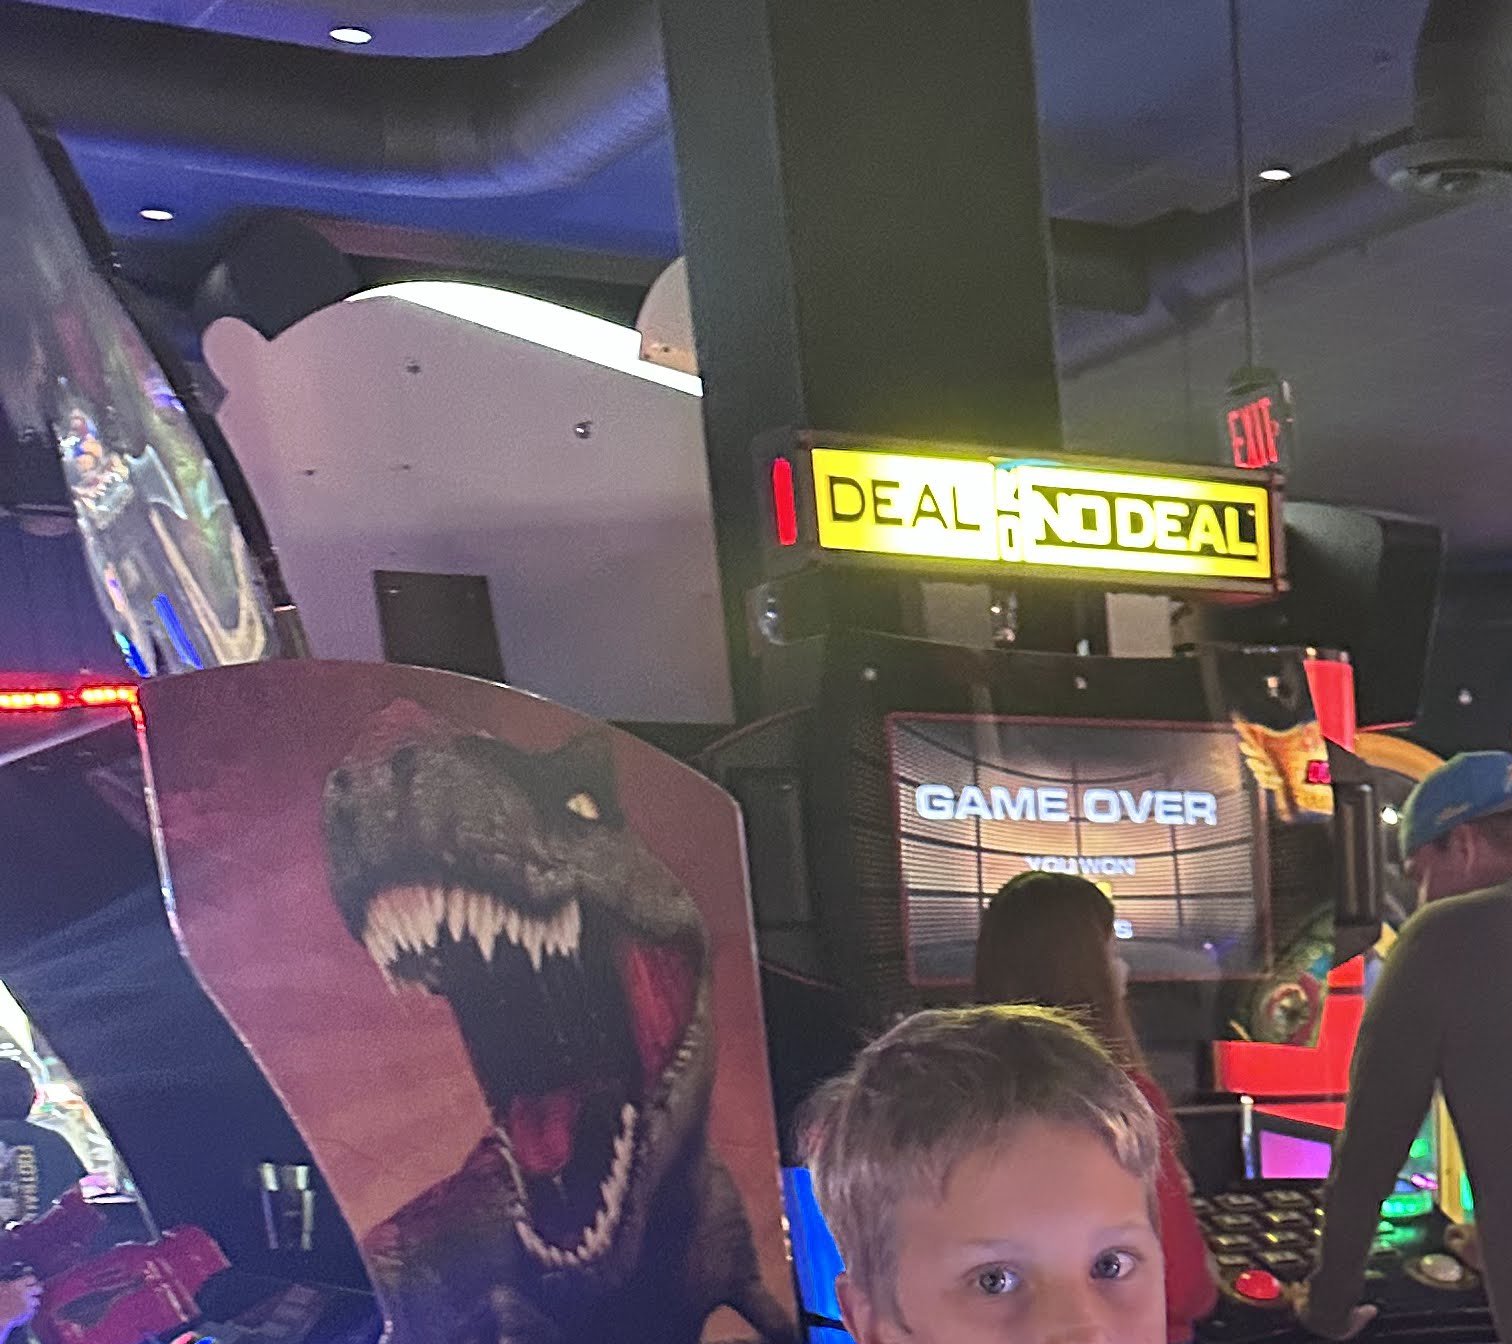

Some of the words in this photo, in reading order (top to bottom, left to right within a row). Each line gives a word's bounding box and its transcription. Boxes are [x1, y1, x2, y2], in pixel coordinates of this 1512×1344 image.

[1227, 397, 1279, 468] EXIT
[828, 475, 981, 532] DEAL
[1032, 487, 1110, 547] NO
[1116, 497, 1257, 557] DEAL
[915, 783, 1070, 822] GAME
[1083, 788, 1217, 826] OVER
[1024, 856, 1078, 875] YOU
[1079, 857, 1136, 875] WON
